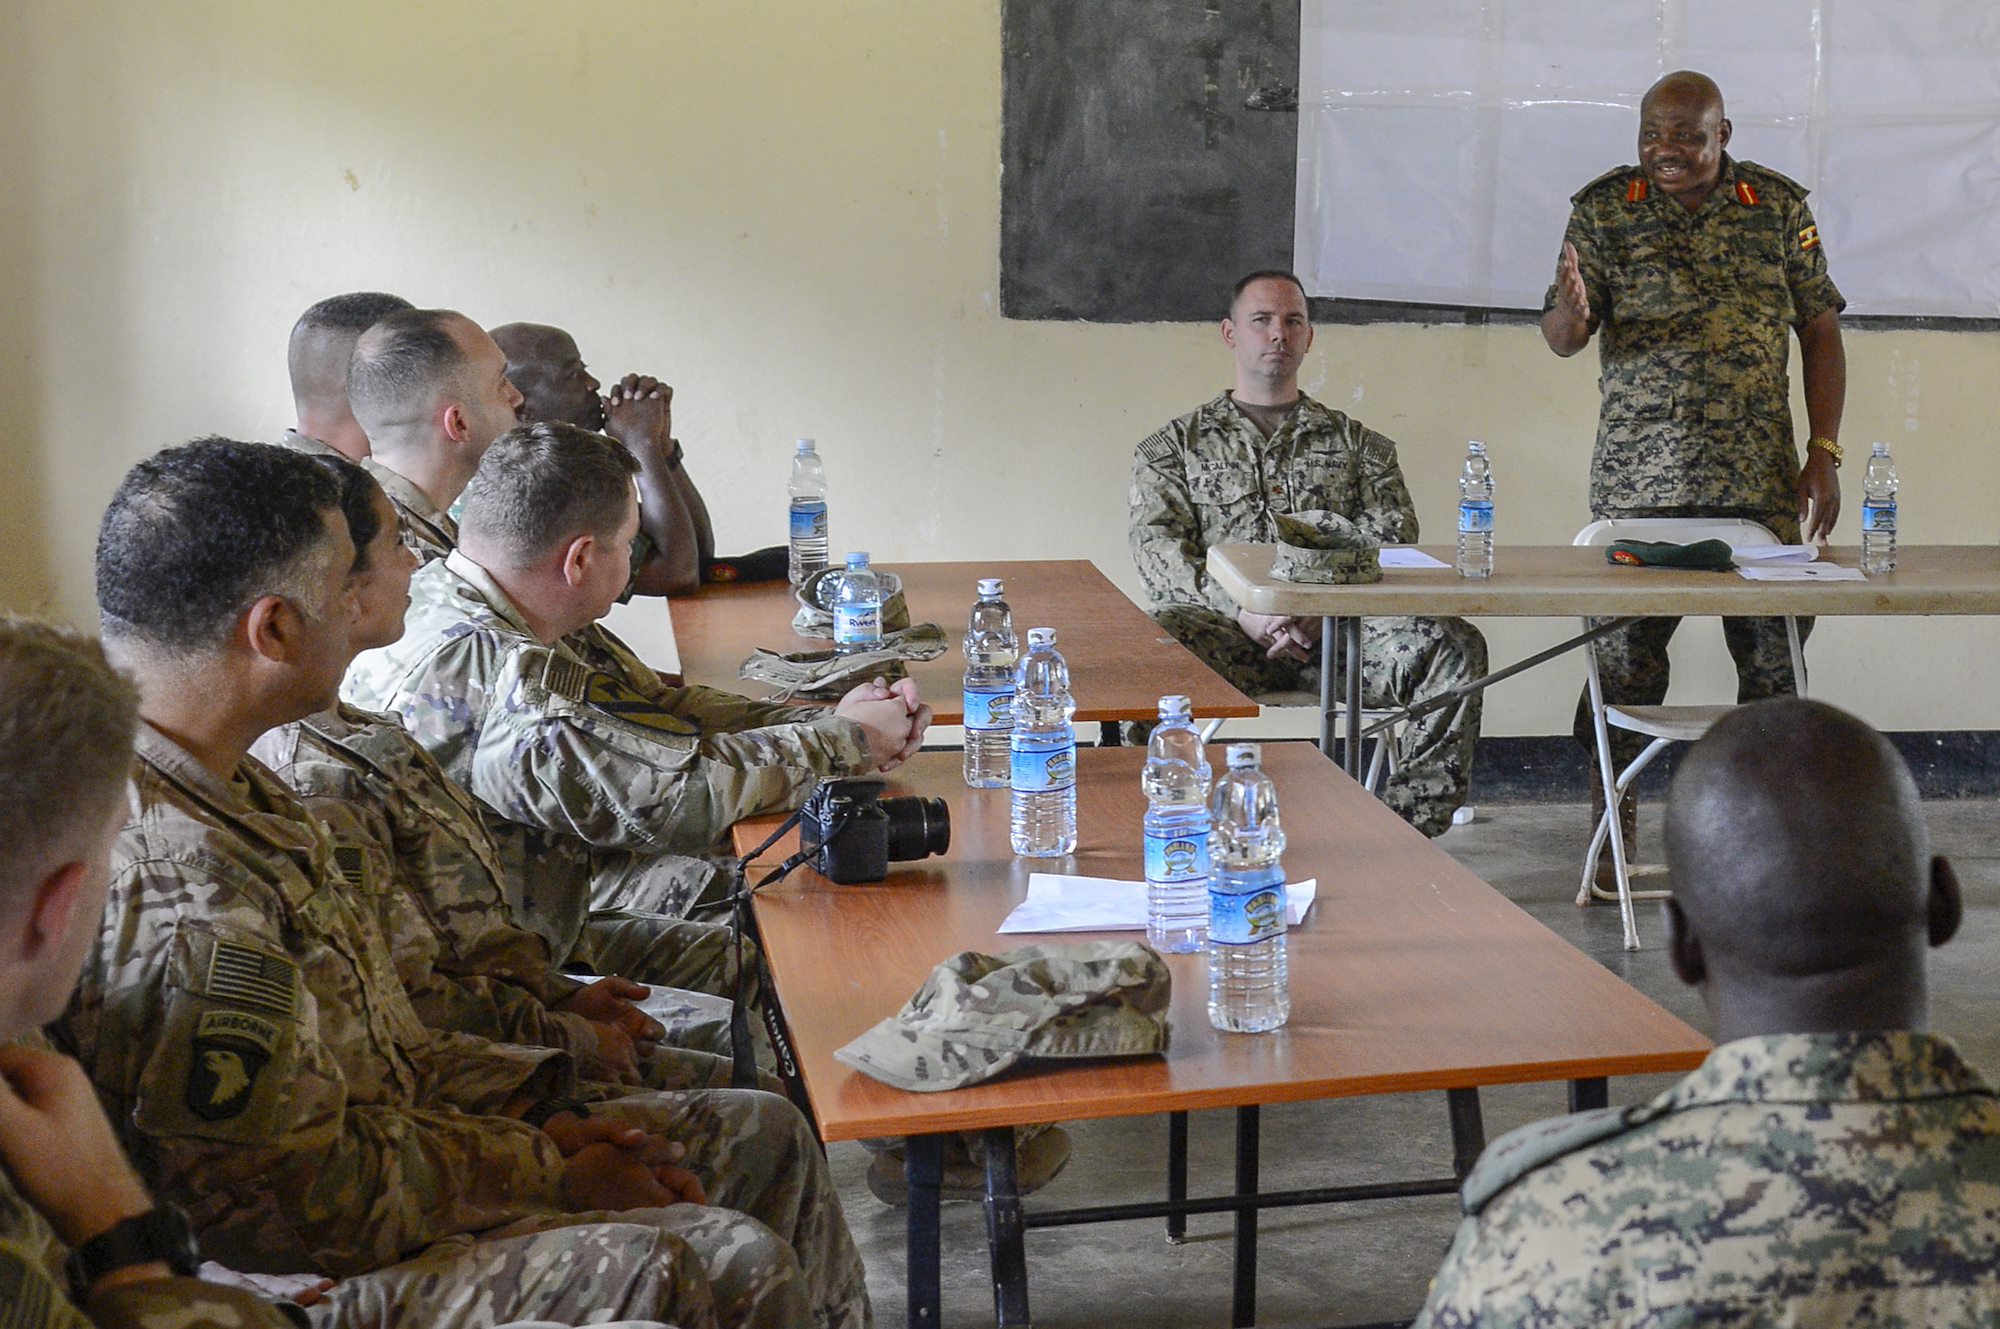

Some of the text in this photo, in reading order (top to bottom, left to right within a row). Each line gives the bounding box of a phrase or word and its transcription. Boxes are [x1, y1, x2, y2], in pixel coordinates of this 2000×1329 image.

[1325, 460, 1348, 469] NAVY
[206, 1015, 274, 1043] AIRBORNE
[766, 1007, 796, 1078] Canon
